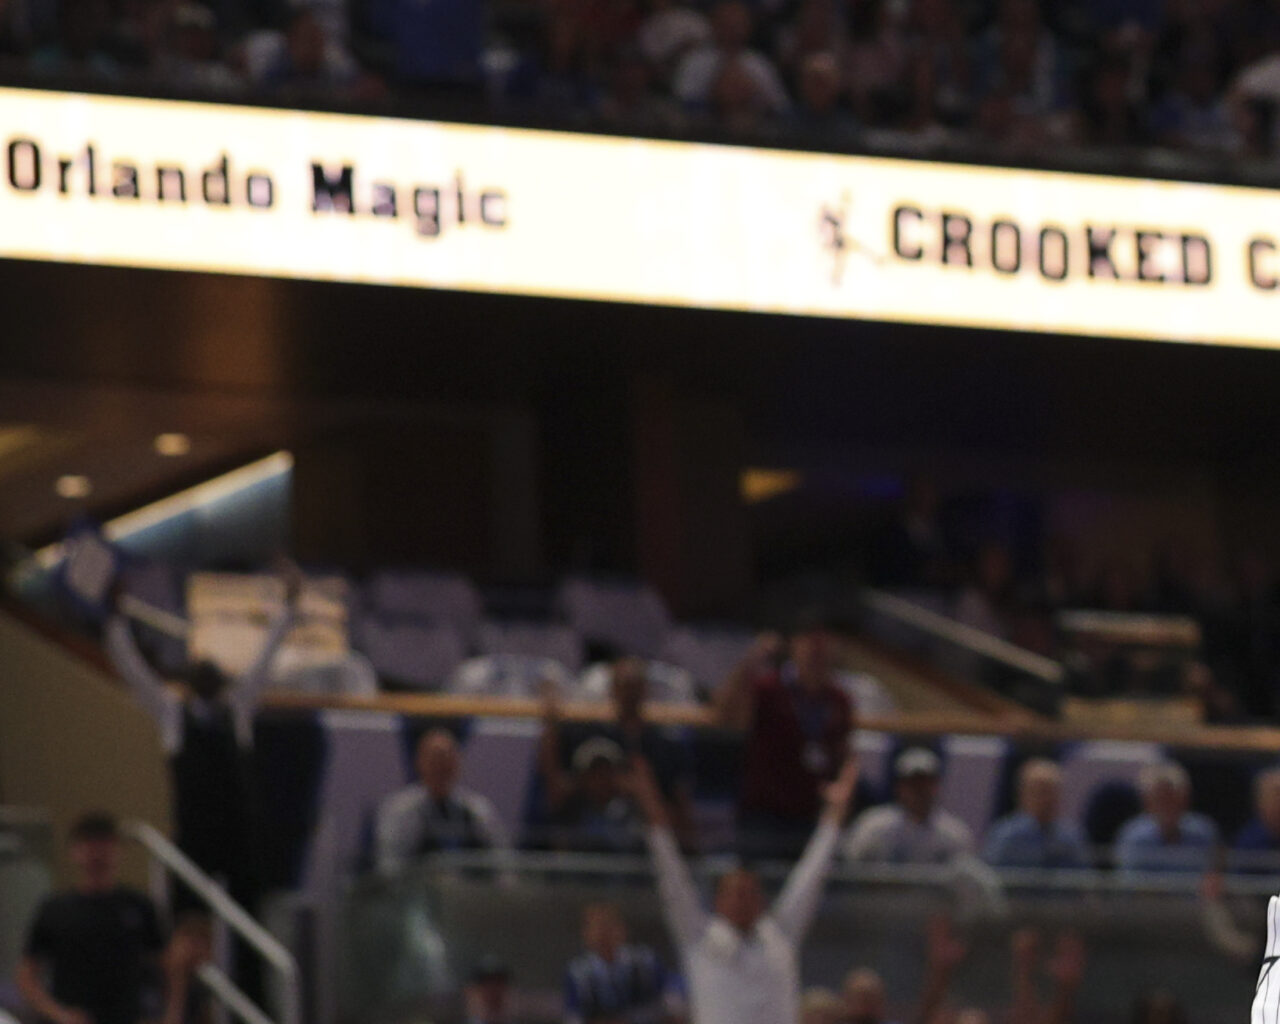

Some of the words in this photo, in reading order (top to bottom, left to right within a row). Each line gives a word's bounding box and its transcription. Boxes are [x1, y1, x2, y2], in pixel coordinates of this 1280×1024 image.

[5, 136, 276, 210] Orlando
[309, 159, 509, 239] Magic
[889, 202, 1215, 288] CROOKED
